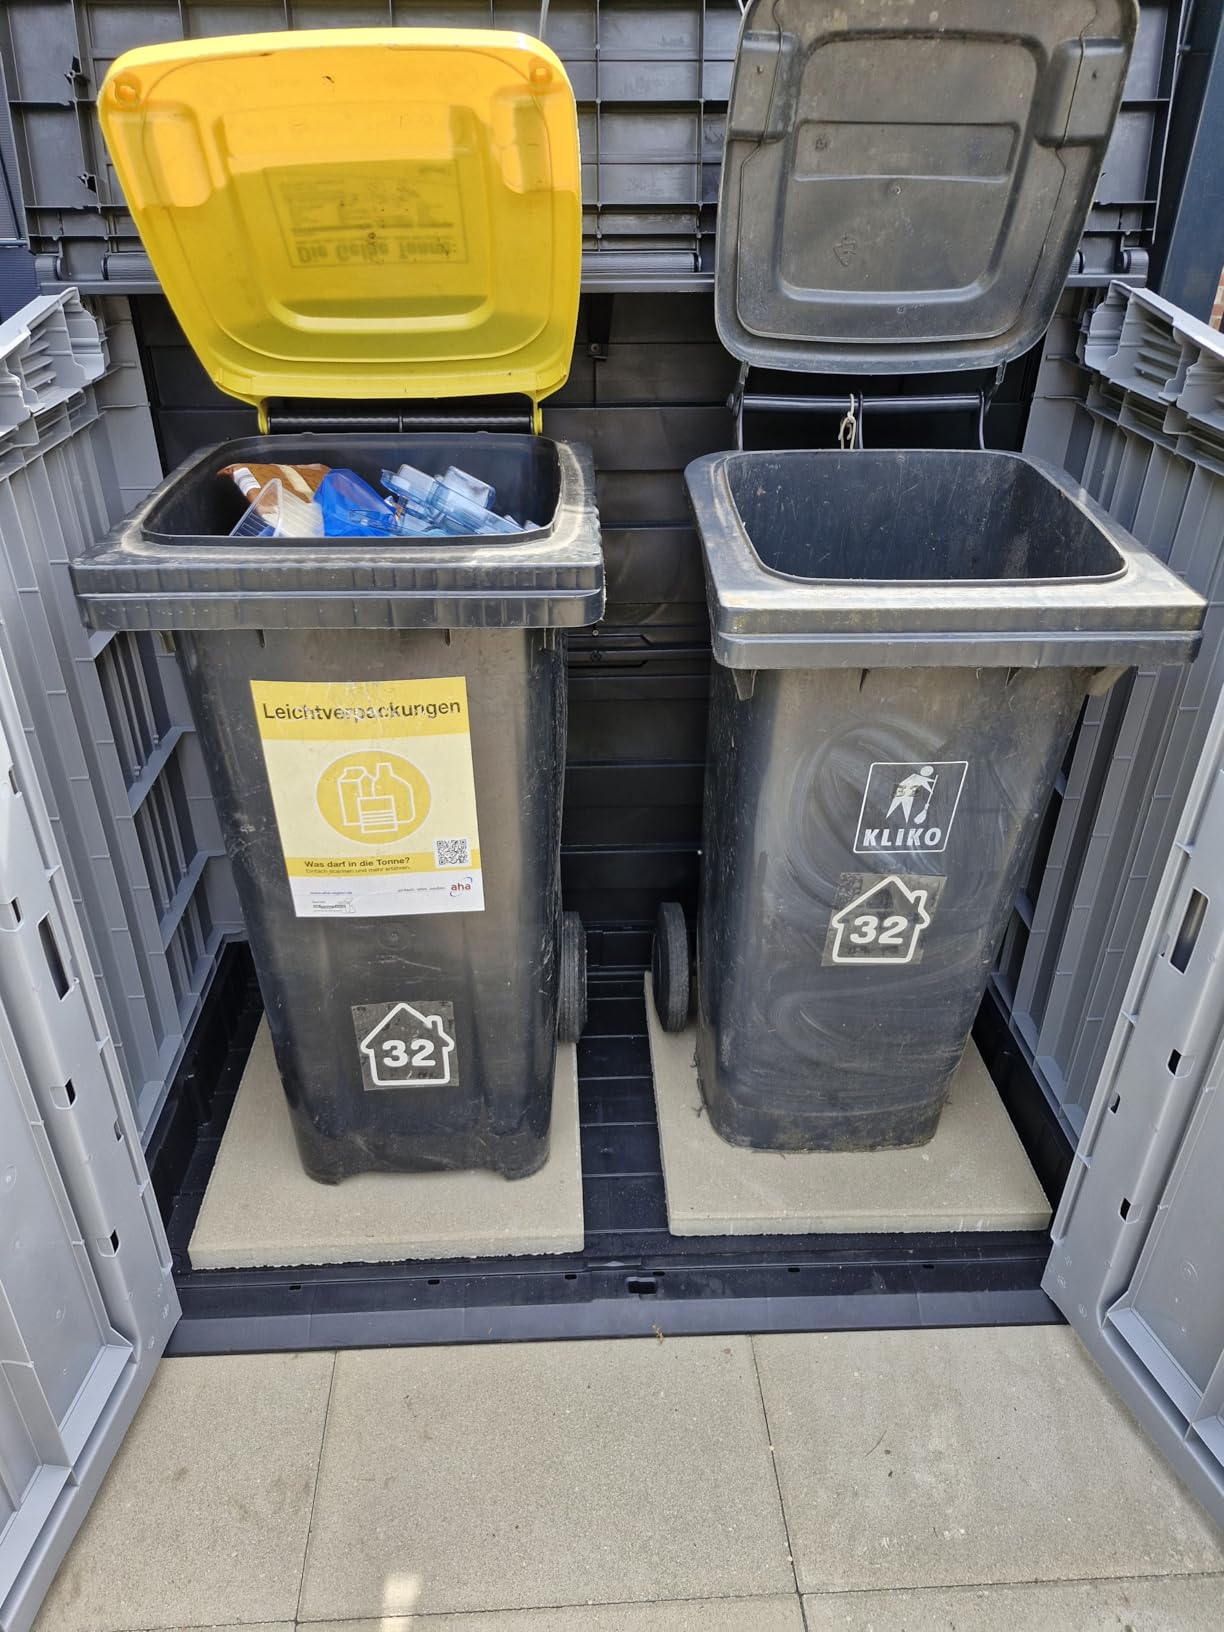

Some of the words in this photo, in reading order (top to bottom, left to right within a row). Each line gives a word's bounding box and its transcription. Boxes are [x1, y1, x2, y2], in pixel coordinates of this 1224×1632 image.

[262, 701, 462, 723] Leichtverpackungen
[862, 827, 942, 847] KLIKO
[304, 860, 325, 868] Was
[327, 860, 346, 868] darf
[359, 859, 374, 867] die
[376, 856, 411, 866] Tonne?
[450, 883, 471, 891] aha
[850, 915, 908, 944] 32
[382, 1038, 436, 1067] 32
